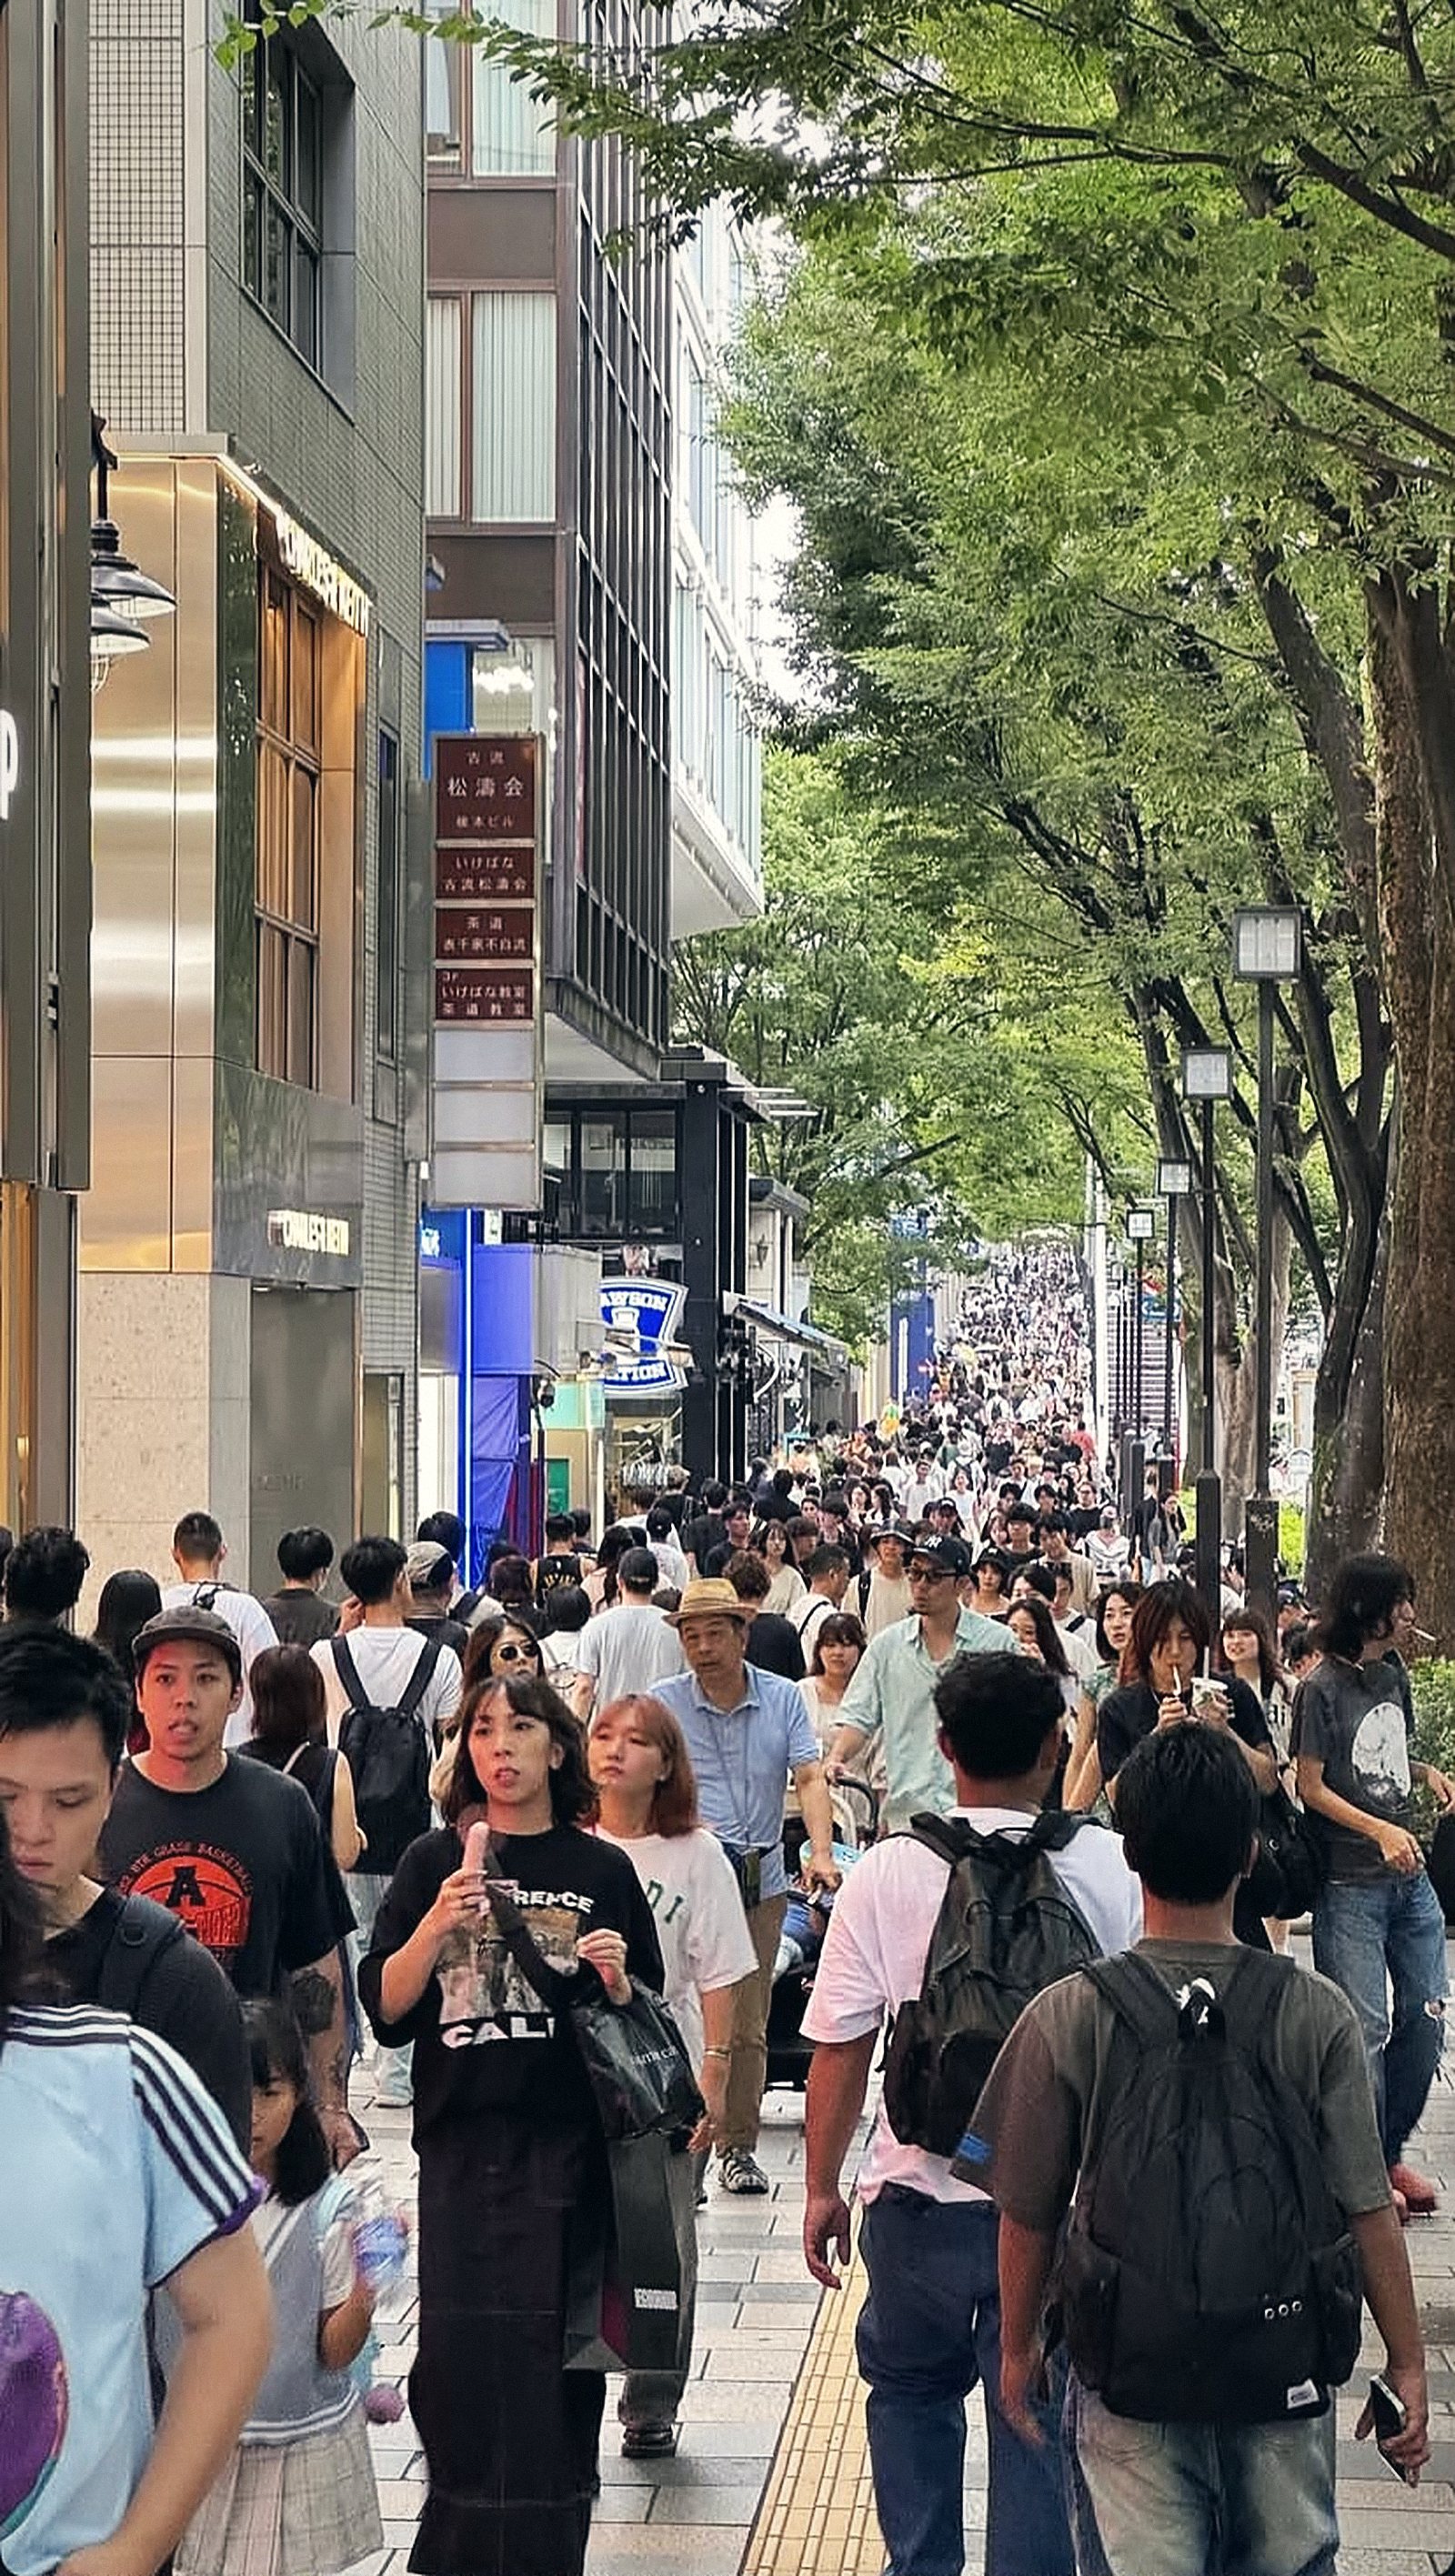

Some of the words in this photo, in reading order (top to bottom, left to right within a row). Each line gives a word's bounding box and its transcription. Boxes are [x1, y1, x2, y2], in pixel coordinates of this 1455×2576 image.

[456, 857, 514, 869] いけばな
[442, 986, 526, 999] いけばな教室
